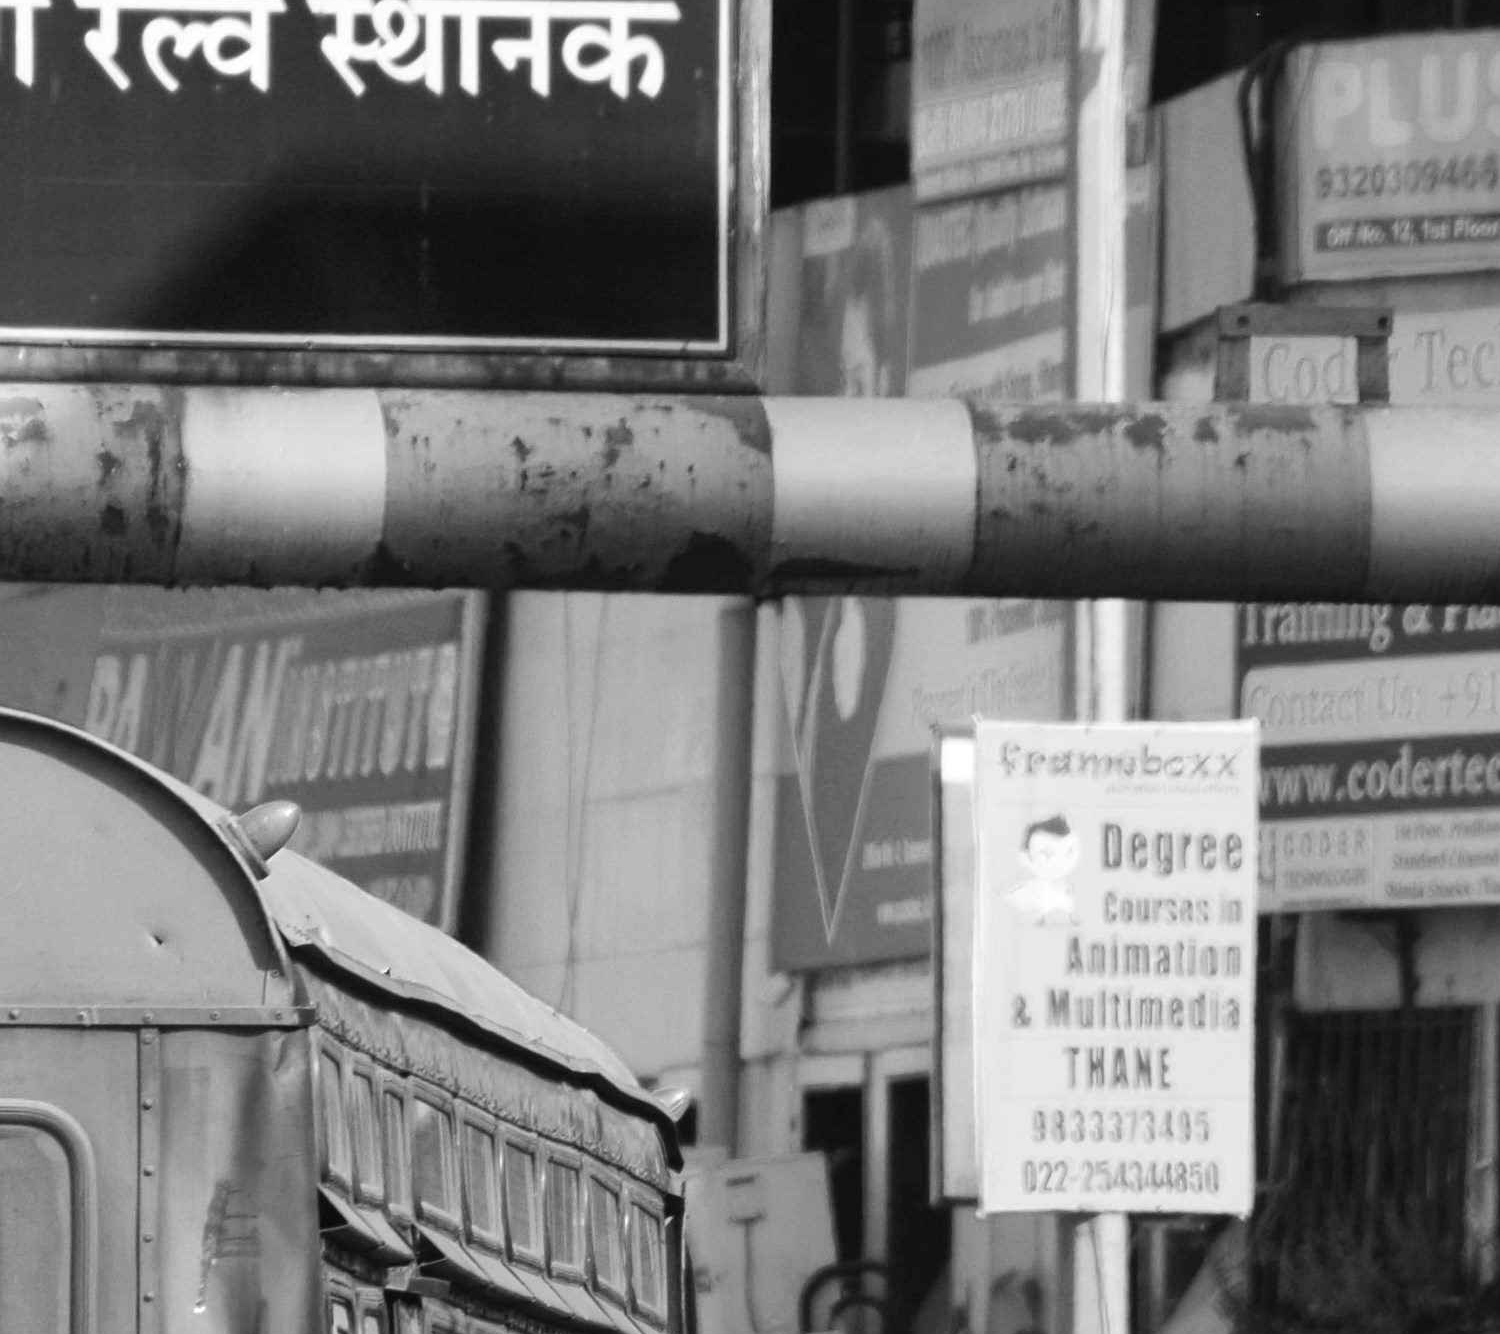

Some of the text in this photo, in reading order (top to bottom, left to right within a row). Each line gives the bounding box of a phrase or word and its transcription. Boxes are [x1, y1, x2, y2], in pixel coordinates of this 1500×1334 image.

[1261, 337, 1400, 403] Codr
[1246, 684, 1365, 728] Contact
[1000, 738, 1243, 780] frameboxx
[1099, 822, 1245, 877] Degree
[1103, 889, 1244, 925] Courses in
[1064, 935, 1243, 979] Animation
[1010, 987, 1242, 1032] & Multimedia
[1062, 1045, 1173, 1091] THANE
